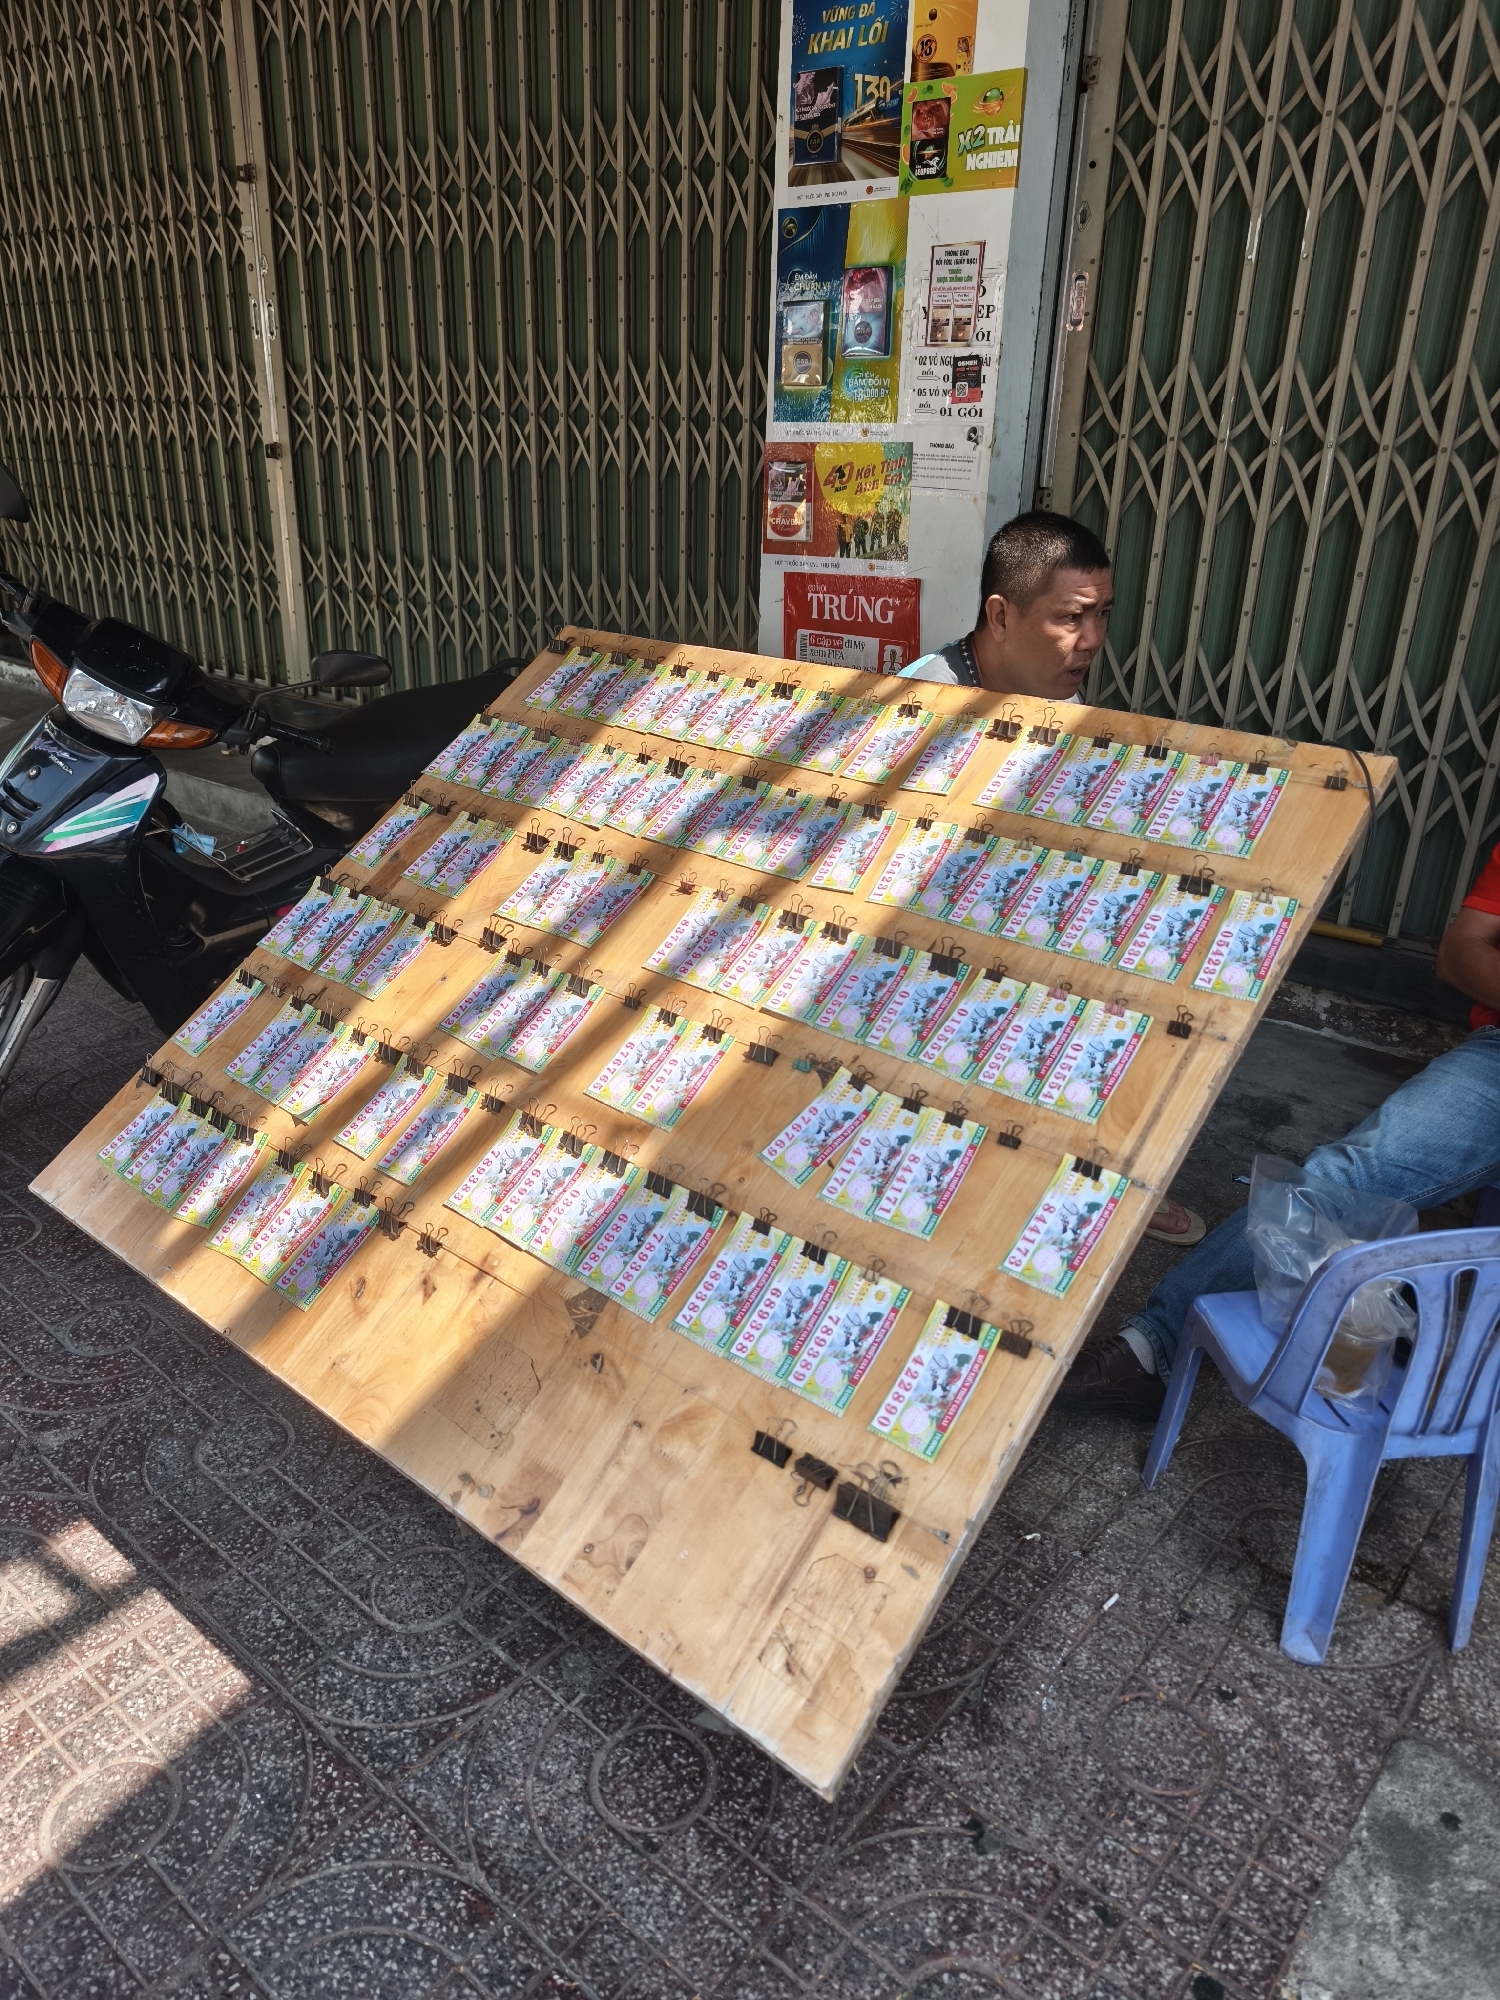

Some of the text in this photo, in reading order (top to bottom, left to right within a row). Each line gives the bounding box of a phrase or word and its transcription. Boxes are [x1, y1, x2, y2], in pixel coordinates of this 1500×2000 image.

[807, 15, 890, 55] KHAI LỐI
[822, 5, 856, 24] VỮNG
[918, 356, 928, 366] 02
[917, 388, 927, 397] 05
[939, 405, 984, 418] 01 GÓI
[809, 648, 845, 660] xem FIFA
[810, 635, 815, 644] 6
[49, 753, 73, 775] HONDA
[906, 744, 938, 784] 201611
[979, 759, 1017, 801] 201613
[608, 786, 650, 824] 293025
[1032, 769, 1071, 813] 201614
[1090, 778, 1126, 823] 201615
[1148, 789, 1183, 835] 201616
[686, 805, 725, 845] 293027
[764, 826, 803, 868] 293029
[432, 848, 472, 884] 837941
[812, 838, 848, 881] 054230
[500, 872, 541, 911] 837943
[532, 881, 572, 922] 837944
[561, 890, 605, 931] 837945
[949, 872, 992, 919] 054233
[1002, 884, 1042, 934] 054234
[288, 915, 329, 956] 015557
[649, 919, 691, 964] 837947
[1058, 897, 1098, 948] 054235
[1118, 913, 1164, 966] 054236
[320, 929, 360, 970] 015558
[351, 943, 395, 984] 015559
[677, 929, 720, 974] 837948
[720, 942, 765, 988] 837949
[1196, 929, 1235, 984] 054237
[442, 981, 488, 1026] 676762
[769, 957, 811, 1006] 041650
[817, 973, 861, 1025] 015550
[178, 998, 222, 1039] 844174
[471, 994, 515, 1039] 776763
[507, 1006, 553, 1054] 050363
[868, 989, 910, 1041] 015551
[920, 1005, 967, 1060] 015552
[226, 1029, 271, 1072] 844176
[255, 1042, 302, 1088] 844177
[591, 1040, 637, 1091] 676765
[984, 1022, 1024, 1082] 015553
[1040, 1041, 1085, 1101] 015554
[634, 1057, 680, 1110] 676766
[100, 1112, 147, 1156] 422893
[340, 1090, 388, 1138] 689380
[763, 1105, 821, 1157] 676769
[126, 1127, 173, 1175] 422894
[381, 1115, 426, 1165] 789381
[146, 1144, 192, 1192] 422895
[178, 1163, 220, 1214] 422896
[452, 1149, 500, 1202] 789383
[823, 1135, 872, 1196] 944170
[877, 1152, 921, 1215] 844171
[213, 1189, 256, 1242] 422897
[493, 1167, 542, 1223] 689384
[531, 1186, 579, 1246] 032784
[243, 1207, 292, 1259] 422898
[579, 1211, 630, 1273] 689385
[1005, 1201, 1056, 1269] 844173
[278, 1230, 328, 1287] 422899
[612, 1231, 663, 1293] 789386
[678, 1258, 729, 1324] 689387
[732, 1286, 784, 1355] 689388
[789, 1313, 840, 1384] 789389
[873, 1353, 927, 1429] 422890
